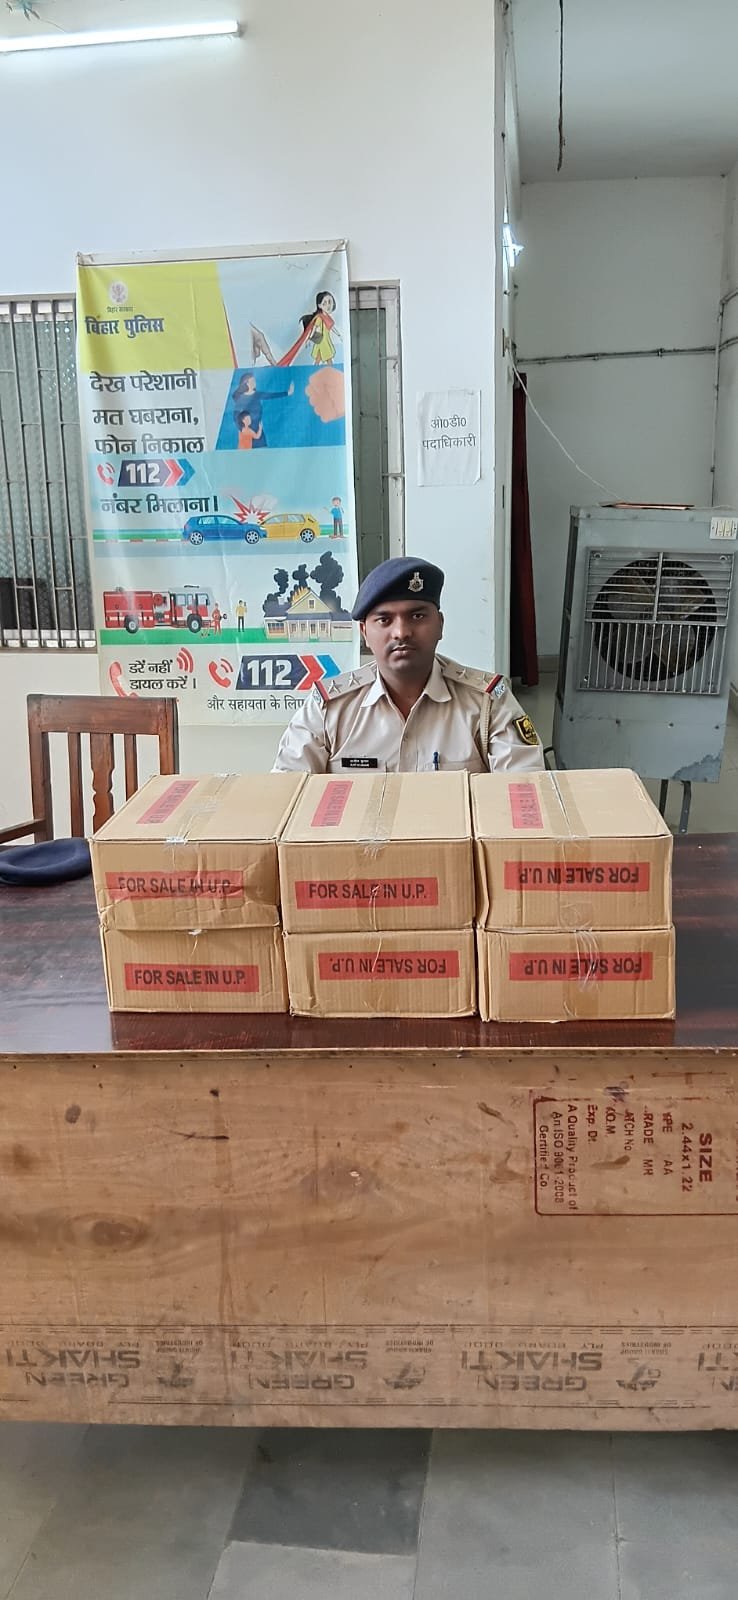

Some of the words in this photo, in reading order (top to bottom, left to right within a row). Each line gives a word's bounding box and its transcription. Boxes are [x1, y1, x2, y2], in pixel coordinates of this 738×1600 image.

[124, 315, 164, 338] पुलिस
[90, 371, 125, 392] देख
[130, 368, 197, 390] परेशानी
[92, 409, 124, 426] मत
[129, 407, 198, 426] घबराना,
[96, 434, 136, 454] फोन
[141, 433, 205, 454] निकाल
[422, 433, 476, 450] पदाधिकारी
[126, 463, 160, 484] 112
[100, 493, 142, 514] नंबर
[128, 659, 146, 674] डरें
[148, 658, 174, 674] नहीं
[247, 660, 292, 686] 112
[129, 678, 164, 690] डायल
[166, 675, 188, 690] करें
[208, 695, 224, 710] और
[228, 697, 266, 712] सहायता
[270, 695, 281, 710] के
[547, 867, 564, 882] IN
[566, 867, 604, 883] SALE
[609, 867, 639, 883] FOR
[118, 877, 145, 894] FOR
[150, 877, 185, 894] SALE
[309, 884, 338, 898] FOR
[342, 884, 379, 899] SALE
[383, 884, 396, 898] IN
[402, 884, 426, 898] U.P.
[330, 958, 355, 972] U.P.
[360, 958, 374, 972] IN
[377, 958, 413, 972] SALE
[418, 959, 446, 973] FOR
[523, 960, 548, 975] U.P.
[552, 960, 566, 974] IN
[570, 959, 608, 974] SALE
[613, 958, 642, 973] FOR
[134, 970, 163, 985] FOR
[166, 970, 201, 985] SALE
[204, 970, 219, 984] IN
[222, 970, 246, 984] U.P.
[568, 1104, 578, 1112] A
[552, 1111, 563, 1126] An
[553, 1130, 564, 1148] ISO
[566, 1116, 578, 1153] Quality
[681, 1122, 694, 1192] 2.44x1.22
[699, 1132, 713, 1182] SIZE
[664, 1160, 674, 1176] AA
[568, 1200, 578, 1211] of
[6, 1348, 141, 1368] SHAKTI
[462, 1350, 603, 1371] SHAKTI
[26, 1372, 130, 1388] GREEN
[248, 1374, 355, 1390] GREEN
[476, 1374, 587, 1392] GREEN
